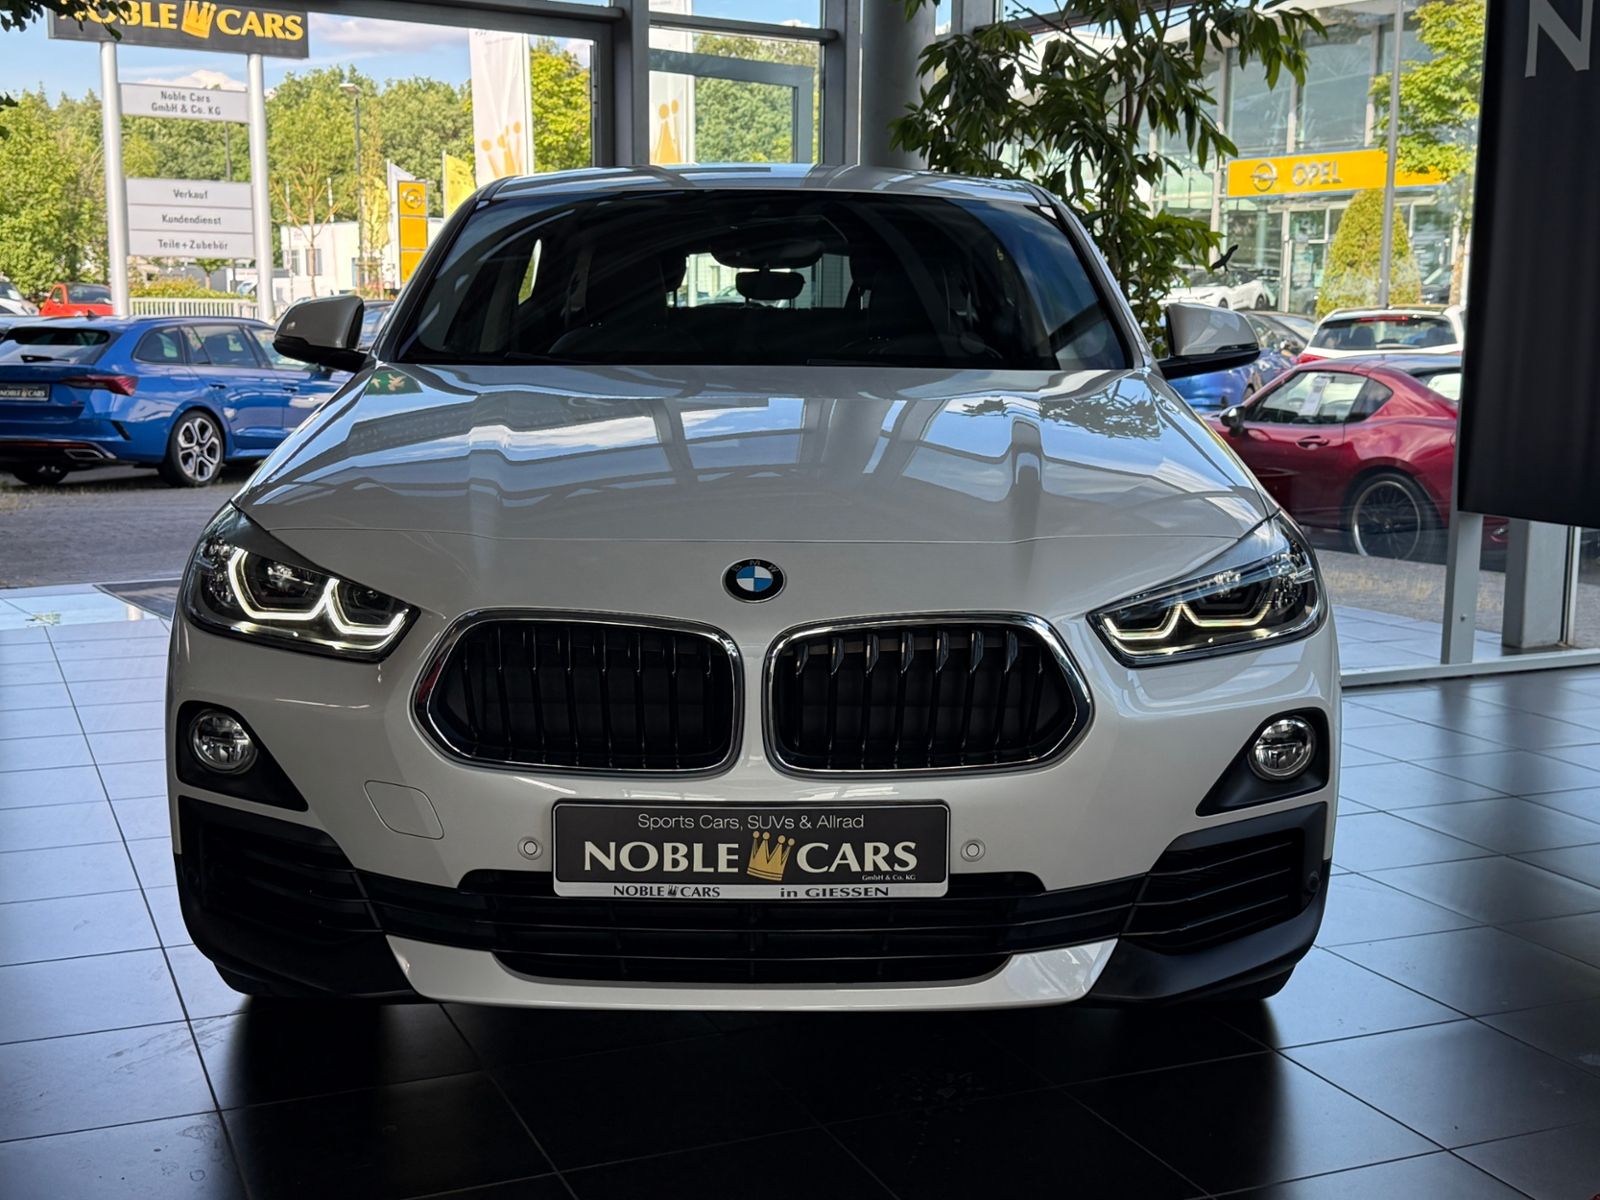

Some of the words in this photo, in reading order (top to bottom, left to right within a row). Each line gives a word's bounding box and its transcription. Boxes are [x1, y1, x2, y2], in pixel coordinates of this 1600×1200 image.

[60, 0, 177, 29] OBLE
[216, 9, 304, 41] CARS
[161, 91, 186, 101] Noble
[190, 92, 211, 103] Cars
[151, 102, 178, 112] GmbH
[181, 105, 188, 113] &
[191, 104, 206, 114] Co.
[208, 106, 221, 115] KG
[1292, 160, 1342, 186] OPEL
[173, 188, 208, 199] Verkauf
[161, 213, 222, 225] Kundendienst
[638, 813, 694, 830] Sports
[700, 815, 743, 831] Cars,
[748, 815, 795, 829] SUVs
[800, 815, 812, 829] &
[816, 815, 864, 829] Allrad
[584, 841, 739, 872] NOBLE
[796, 841, 918, 873] CARS
[613, 885, 665, 897] NOBLE
[680, 886, 720, 897] CARS
[780, 887, 798, 898] in
[804, 887, 889, 898] GIESSEN
